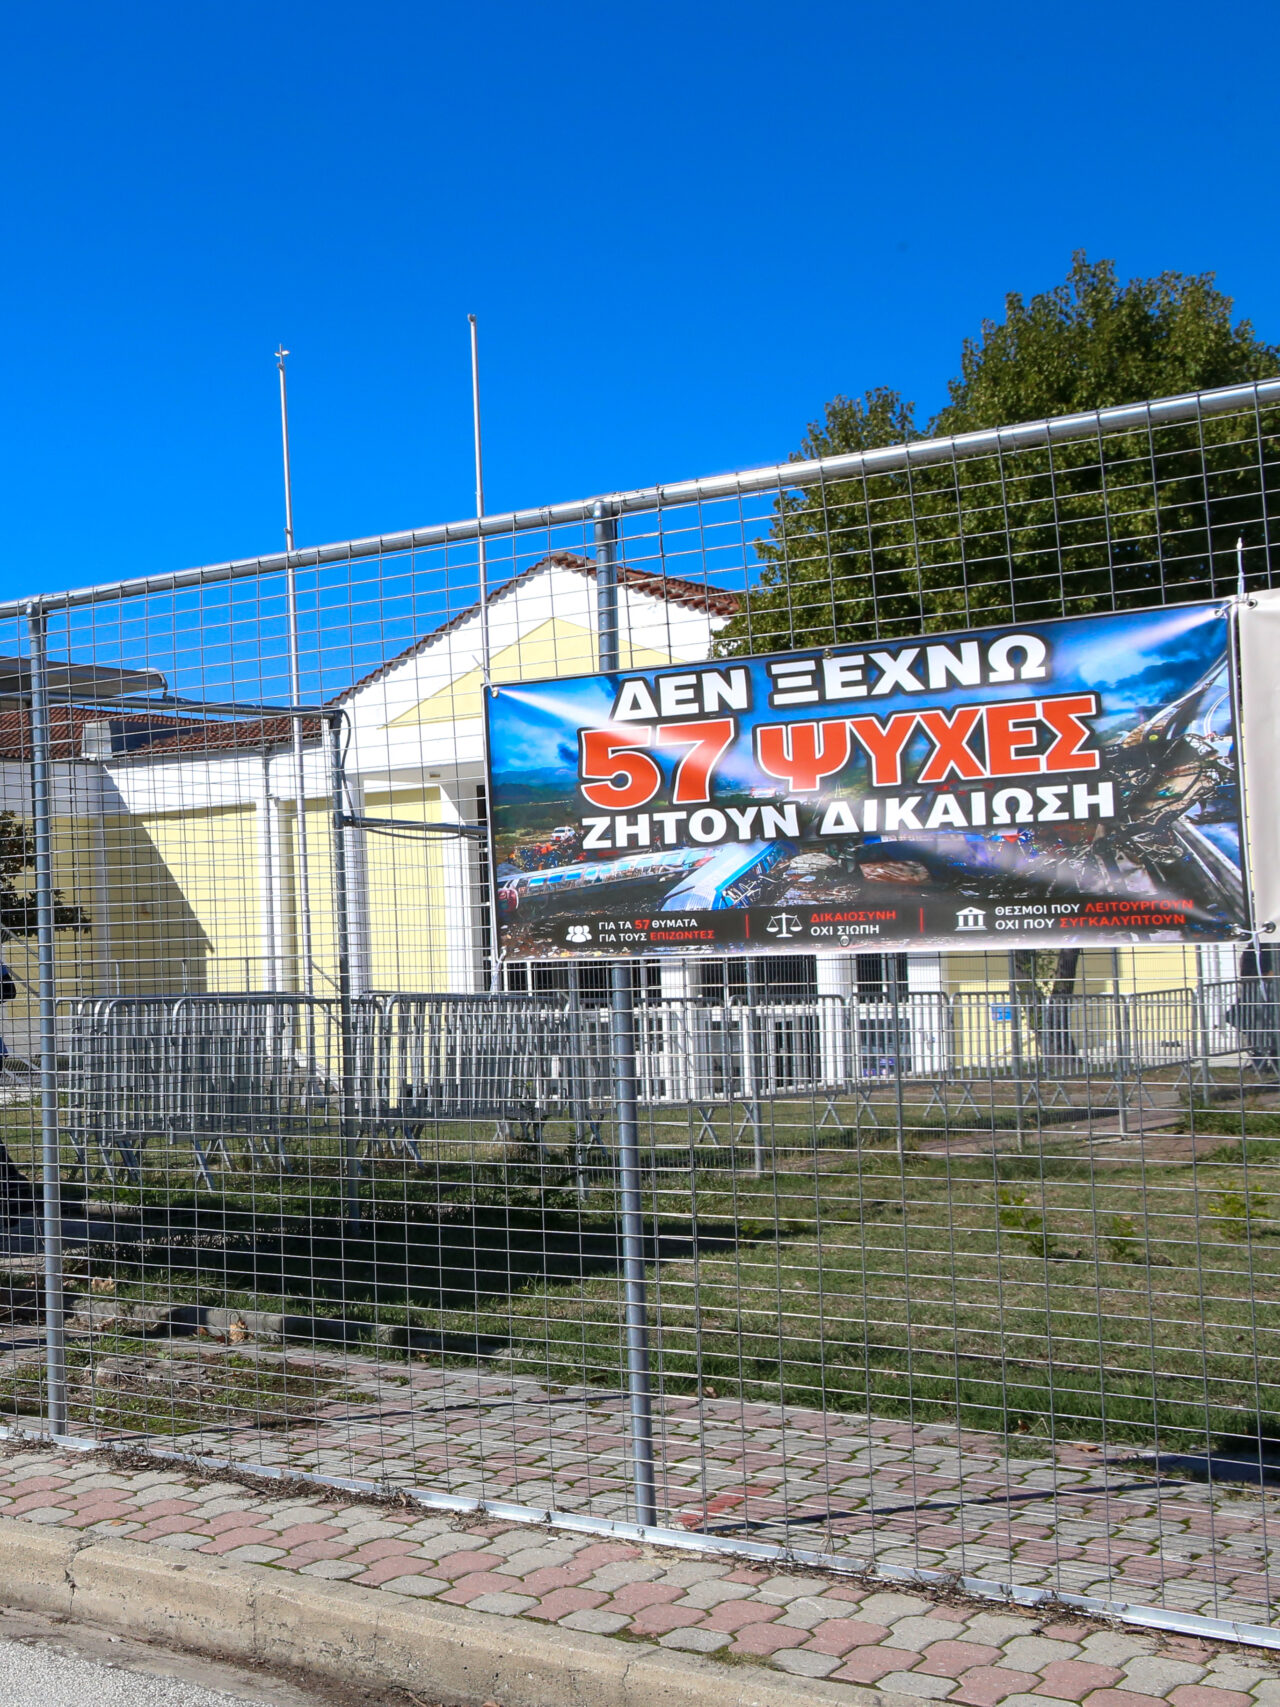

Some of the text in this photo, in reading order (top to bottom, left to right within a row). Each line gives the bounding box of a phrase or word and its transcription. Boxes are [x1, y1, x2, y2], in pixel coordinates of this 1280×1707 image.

[613, 634, 1046, 721] ΔΕΝ ΞΕΧΝΩ
[581, 694, 1100, 810] 57 ΨΥΧΕΣ
[581, 781, 1115, 849] ΖΗΤΟΥΝ ΔΙΚΑΙΩΣΗ
[994, 899, 1193, 916] ΘΕΣΜΟΙ ΠΟΥ ΛΕΙΤΟΥΡΓΟΥΝ
[598, 918, 698, 930] ΓΙΑ ΤΑ 57 ΘΥΜΑΤΑ
[810, 910, 896, 923] ΔΙΚΑΙΟΣΥΝΗ
[994, 914, 1186, 930] ΟΧΙ ΠΟΥ ΣΥΓΚΑΛΥΠΤΟΥΝ
[599, 930, 715, 942] ΓΙΑ ΤΟΥΣ ΕΠΙΖΩΝΤΕΣ
[810, 924, 880, 936] ΟΧΙ ΣΙΩΠΗ
